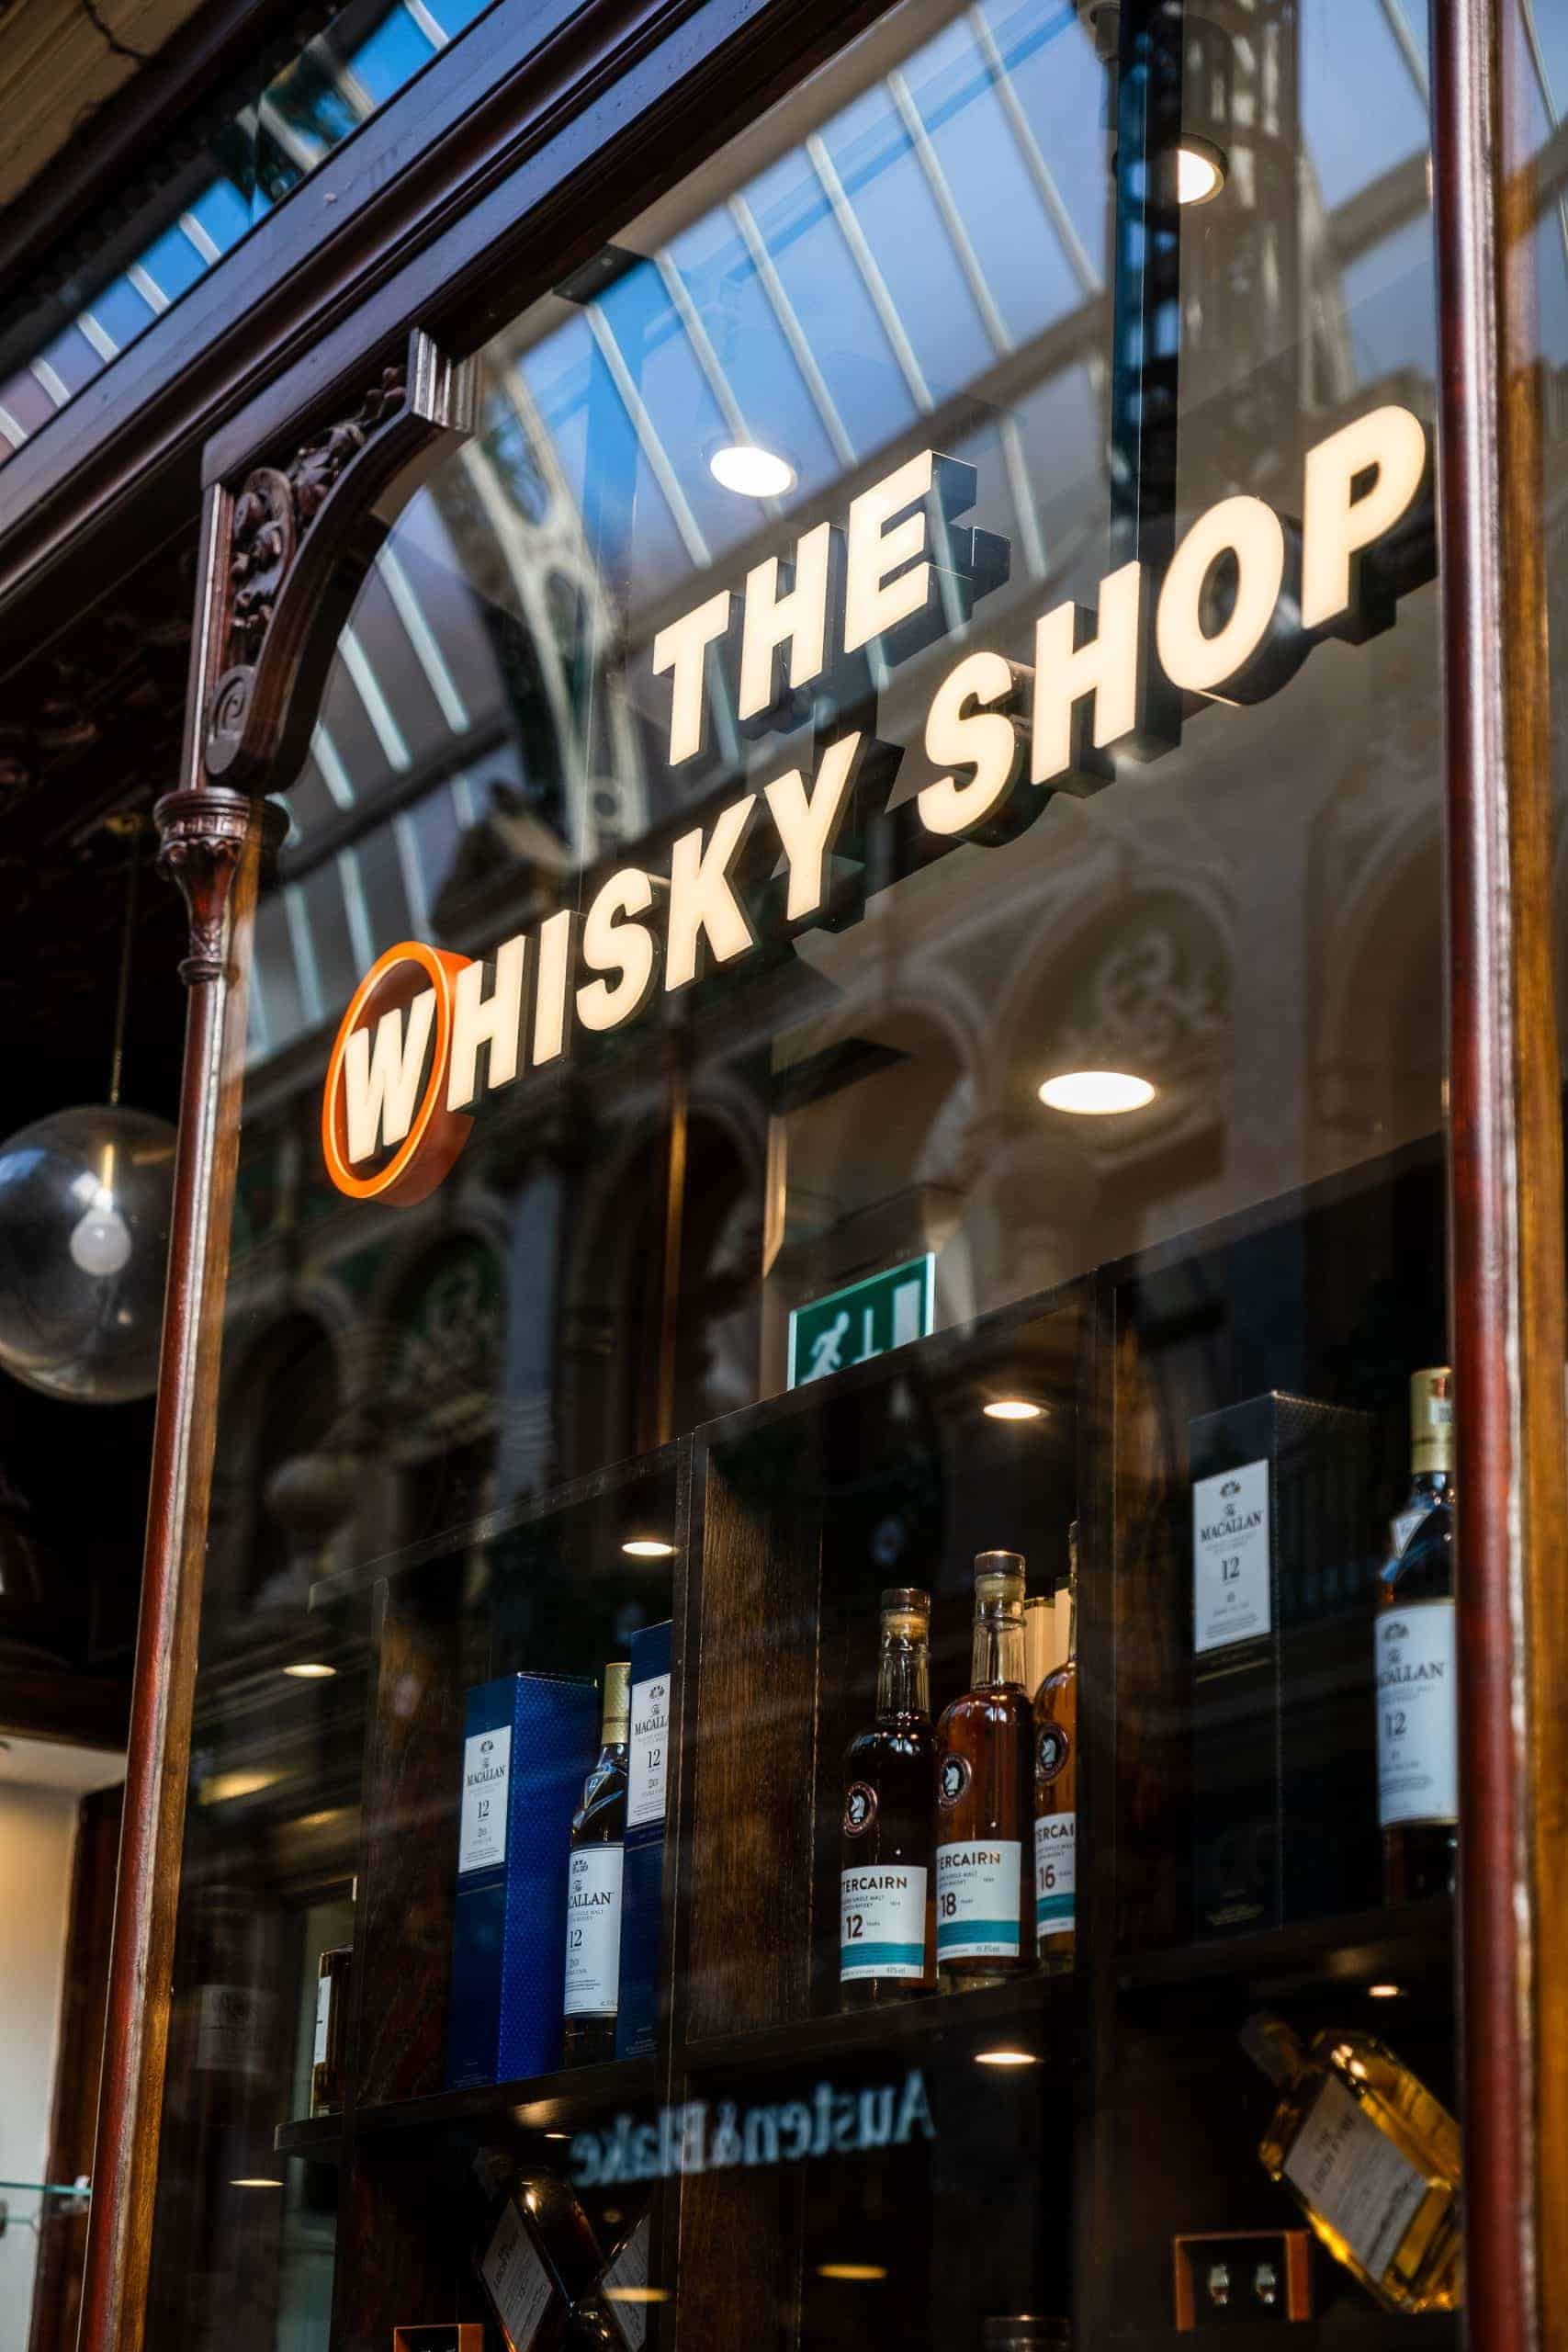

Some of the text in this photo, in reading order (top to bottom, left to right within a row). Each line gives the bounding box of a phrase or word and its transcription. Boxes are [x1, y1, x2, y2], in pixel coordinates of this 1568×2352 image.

[653, 448, 933, 766] THE
[344, 404, 1427, 1166] WHISKY SHOP
[1200, 1511, 1262, 1543] MACALLAN
[1221, 1556, 1240, 1581] 12
[1379, 1661, 1445, 1687] CALLAN
[1385, 1712, 1406, 1737] 12
[647, 1748, 661, 1769] 12
[467, 1765, 505, 1787] MACALLAN
[477, 1800, 490, 1819] 12
[1039, 1864, 1055, 1892] 16
[941, 1893, 956, 1917] 18
[570, 1929, 582, 1949] 12
[846, 1914, 863, 1939] 12
